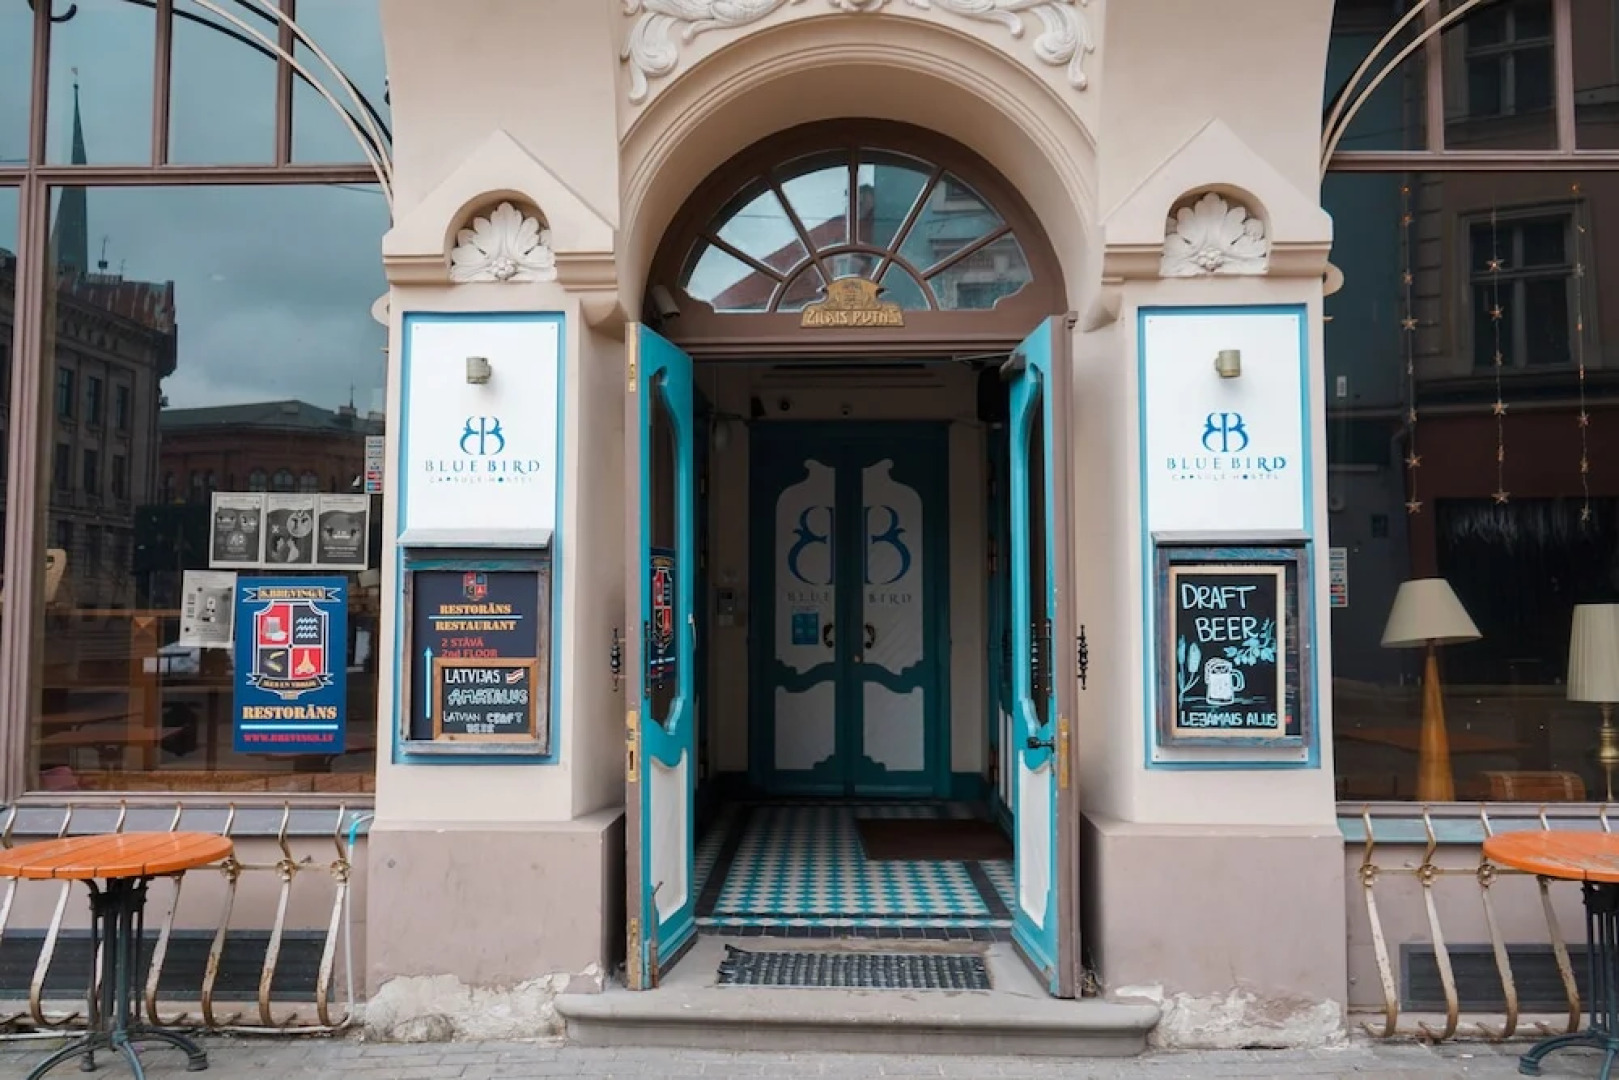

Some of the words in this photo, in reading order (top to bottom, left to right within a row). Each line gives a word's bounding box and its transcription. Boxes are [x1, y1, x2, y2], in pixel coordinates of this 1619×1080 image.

[425, 460, 478, 472] BLUE
[488, 460, 540, 474] BIRD
[1166, 457, 1221, 470] BLUE
[1231, 457, 1287, 472] BIRD
[869, 593, 912, 605] BIRD
[1181, 582, 1257, 610] DRAFT
[439, 602, 512, 615] RESTORĀNS
[435, 621, 517, 631] RESTAURANT
[1195, 616, 1259, 642] BEER
[441, 638, 447, 647] 2
[463, 649, 498, 658] FLOOR
[445, 668, 500, 684] LATVIJAS
[242, 704, 337, 720] RESTORĀNS
[443, 711, 480, 723] LATVIAN
[1246, 711, 1277, 726] ALUS
